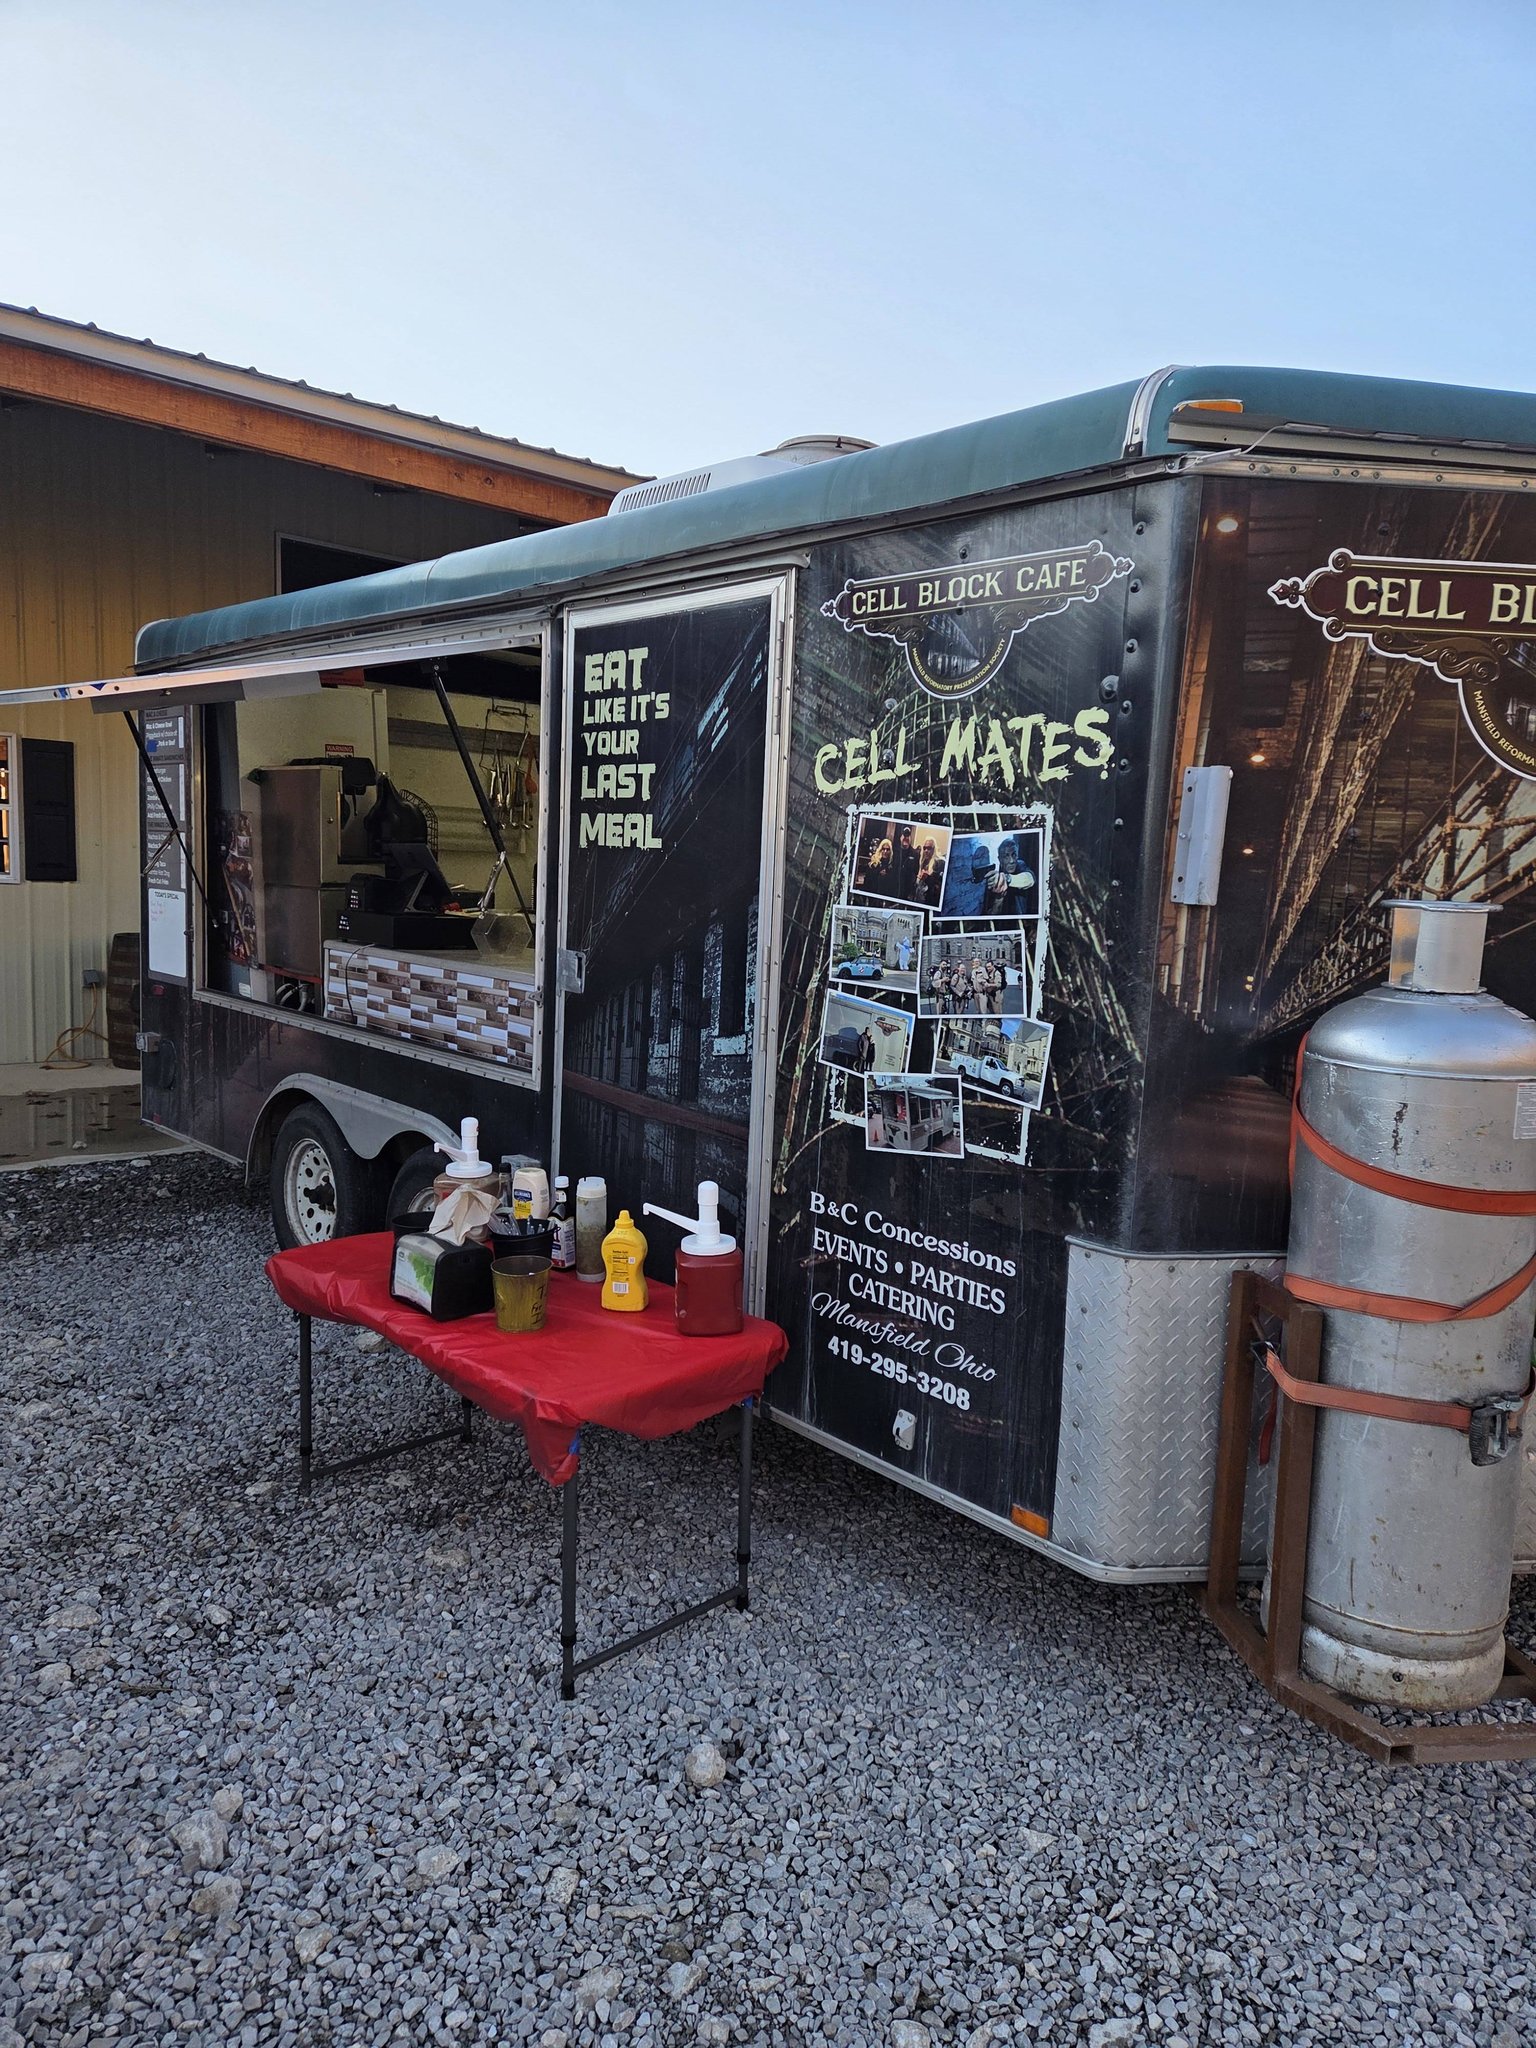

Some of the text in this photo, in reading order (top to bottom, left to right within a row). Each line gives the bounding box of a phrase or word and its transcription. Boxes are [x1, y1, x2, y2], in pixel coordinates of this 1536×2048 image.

[852, 558, 1088, 615] CELL BLOCK CAFE
[1345, 575, 1536, 624] CELL BL
[584, 647, 649, 694] EAT
[912, 638, 1006, 691] MANSFIELD REFORMATORY PRESERVATION SOCIETY
[582, 691, 670, 726] LIKE IT'S
[1474, 690, 1536, 766] MANSFIELD REFORMA
[581, 729, 640, 760] YOUR
[813, 706, 1115, 795] CELL MATES
[580, 763, 656, 802] LAST
[579, 812, 663, 851] MEAL
[810, 1191, 1017, 1277] B&C Concessions
[813, 1227, 1006, 1315] EVENTS PARTIES
[848, 1273, 955, 1331] CATERING
[811, 1292, 997, 1382] Mansfield Ohio
[827, 1335, 971, 1411] 419-295-3208
